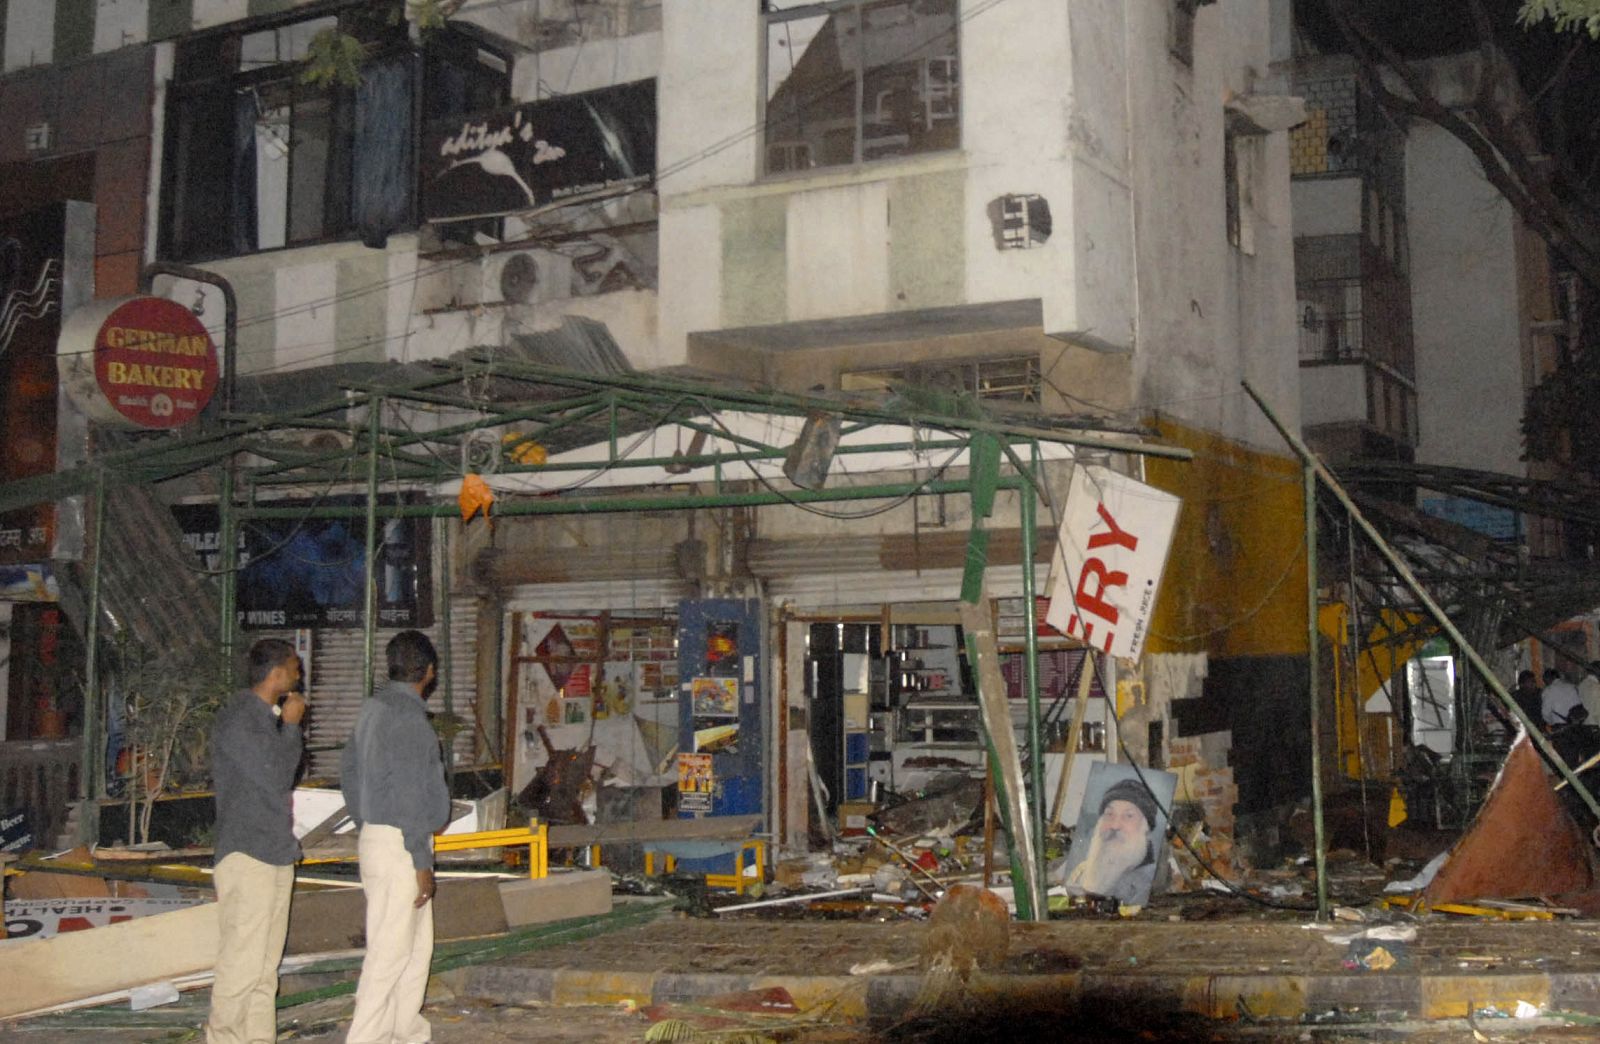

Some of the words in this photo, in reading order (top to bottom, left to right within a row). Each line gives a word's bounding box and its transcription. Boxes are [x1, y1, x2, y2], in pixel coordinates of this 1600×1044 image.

[106, 327, 208, 356] GERMAN
[108, 361, 205, 390] BAKERY
[247, 610, 286, 625] WINES
[1130, 619, 1143, 653] FRESH
[1140, 589, 1152, 616] JUICE
